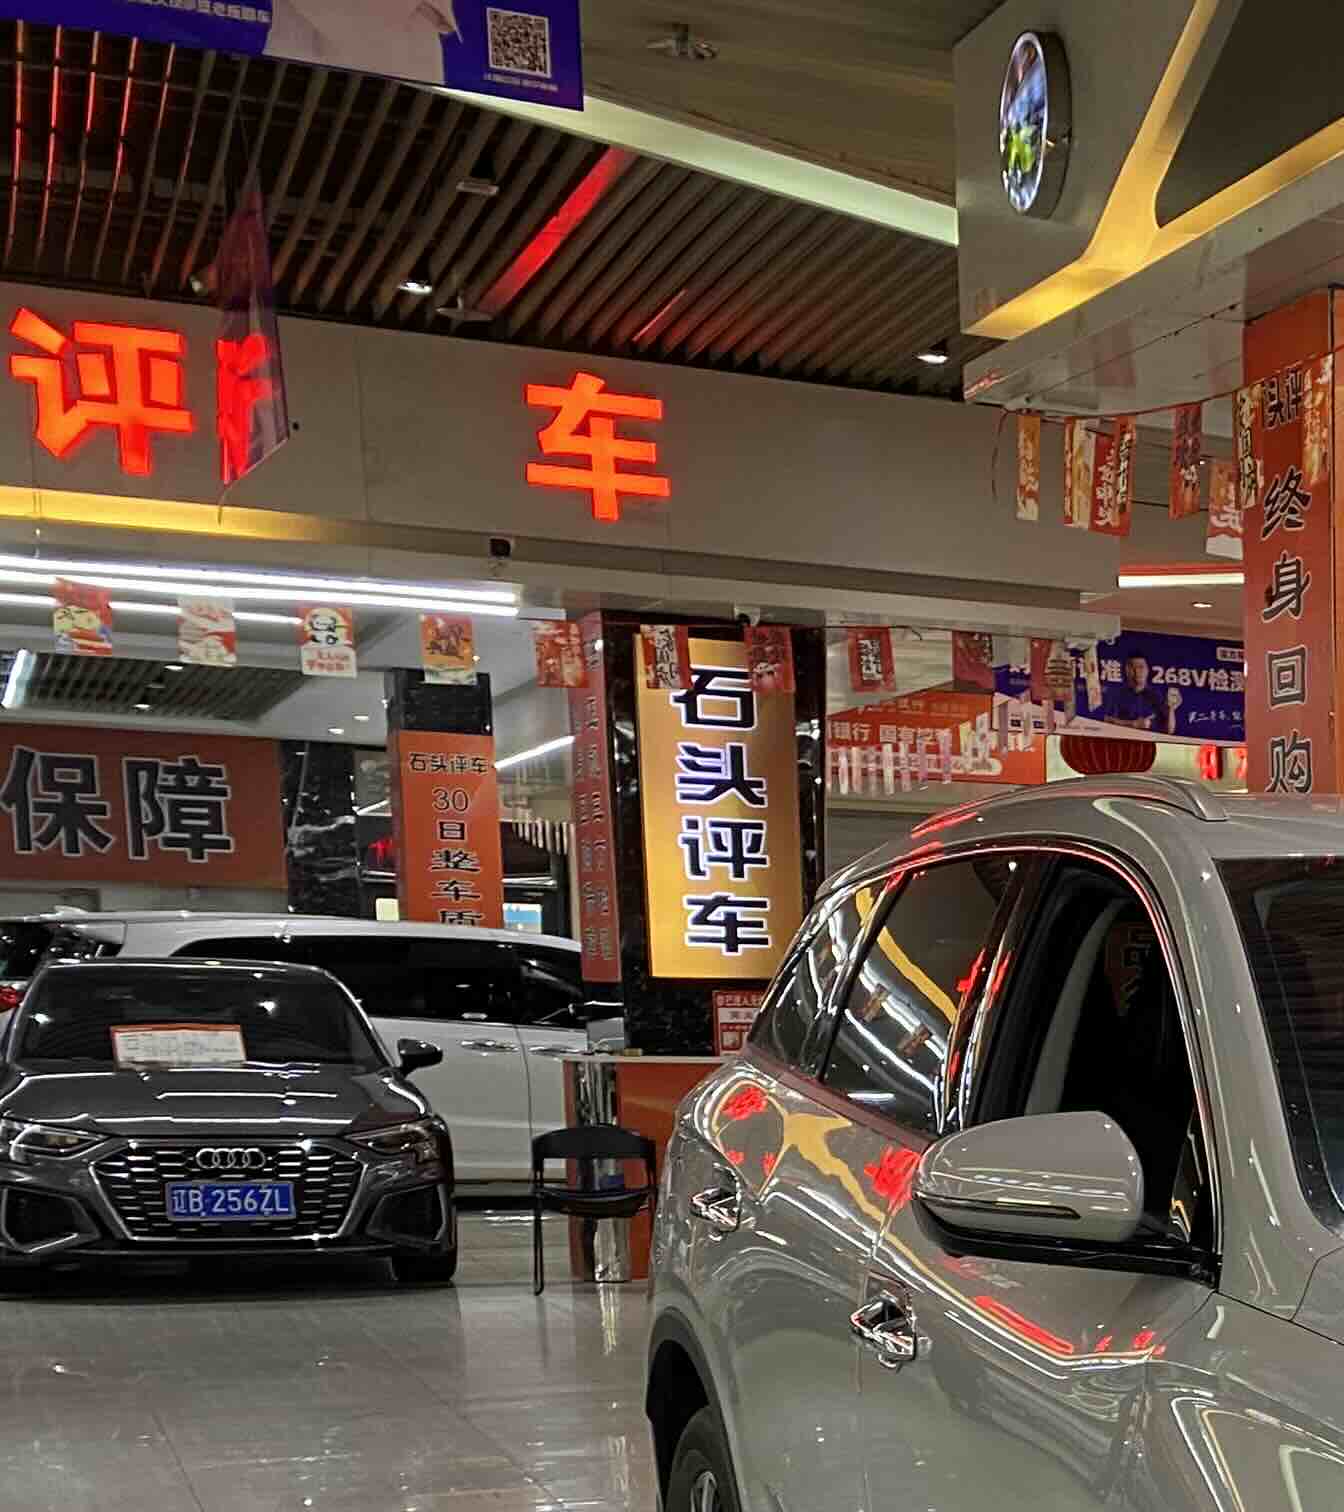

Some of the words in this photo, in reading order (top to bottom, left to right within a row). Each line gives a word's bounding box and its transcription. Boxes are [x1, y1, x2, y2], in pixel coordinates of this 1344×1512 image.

[1260, 464, 1314, 793] 终身回购
[2, 744, 235, 863] 保障
[409, 751, 489, 774] 石头评车
[670, 666, 771, 956] 石头评车
